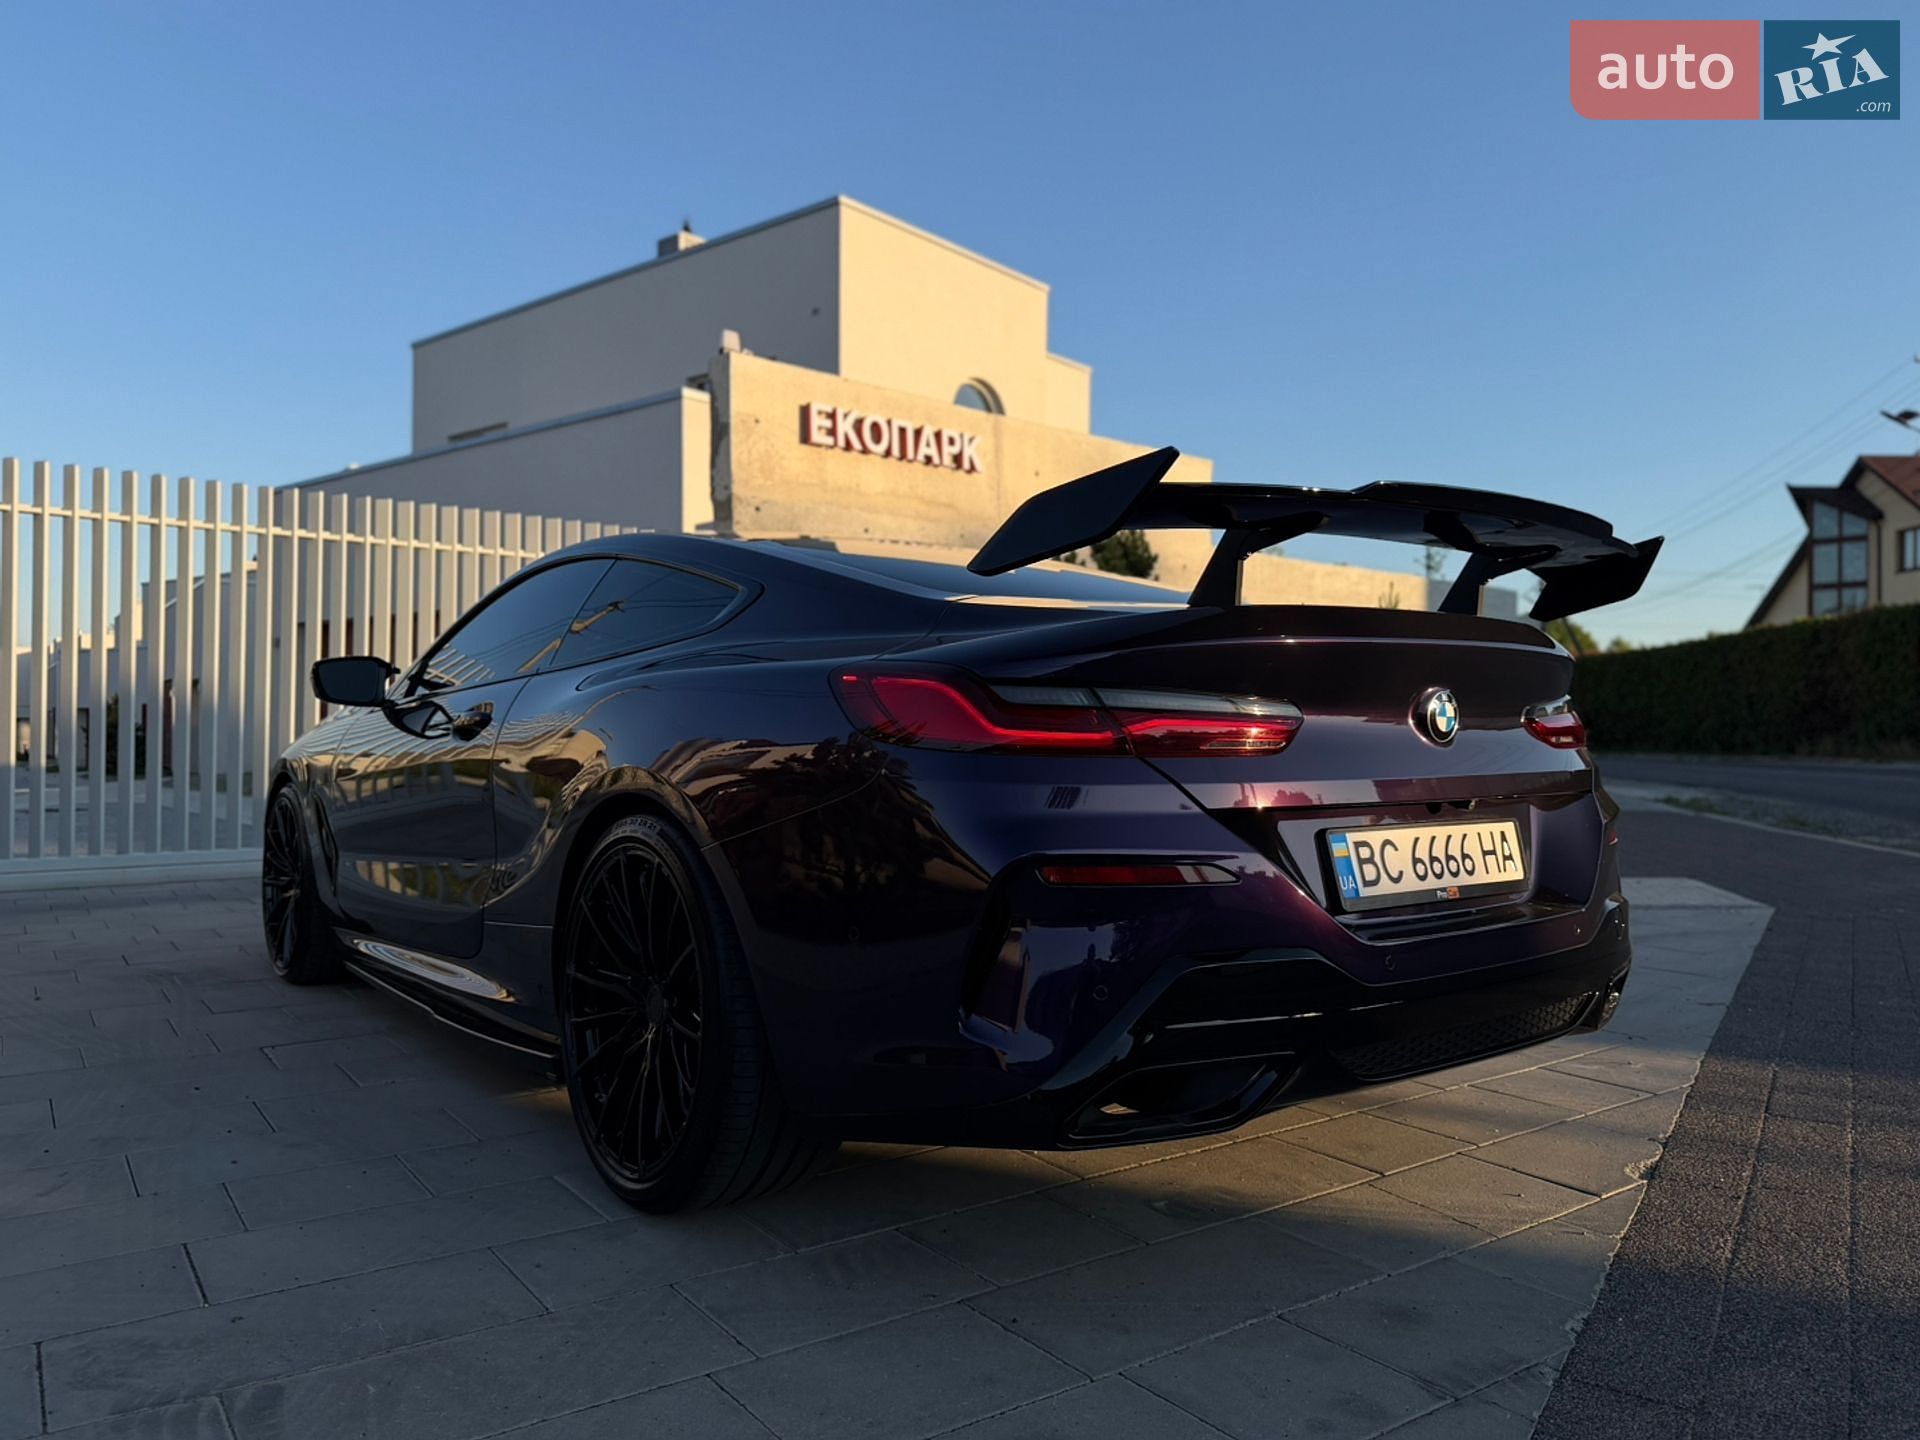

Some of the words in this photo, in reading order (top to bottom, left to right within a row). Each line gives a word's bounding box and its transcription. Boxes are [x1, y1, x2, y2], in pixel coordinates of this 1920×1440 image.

[801, 402, 984, 475] ЕКОПАРК
[1339, 876, 1357, 890] UA
[1353, 839, 1404, 888] BC
[1411, 833, 1476, 882] 6666
[1477, 830, 1518, 875] HA
